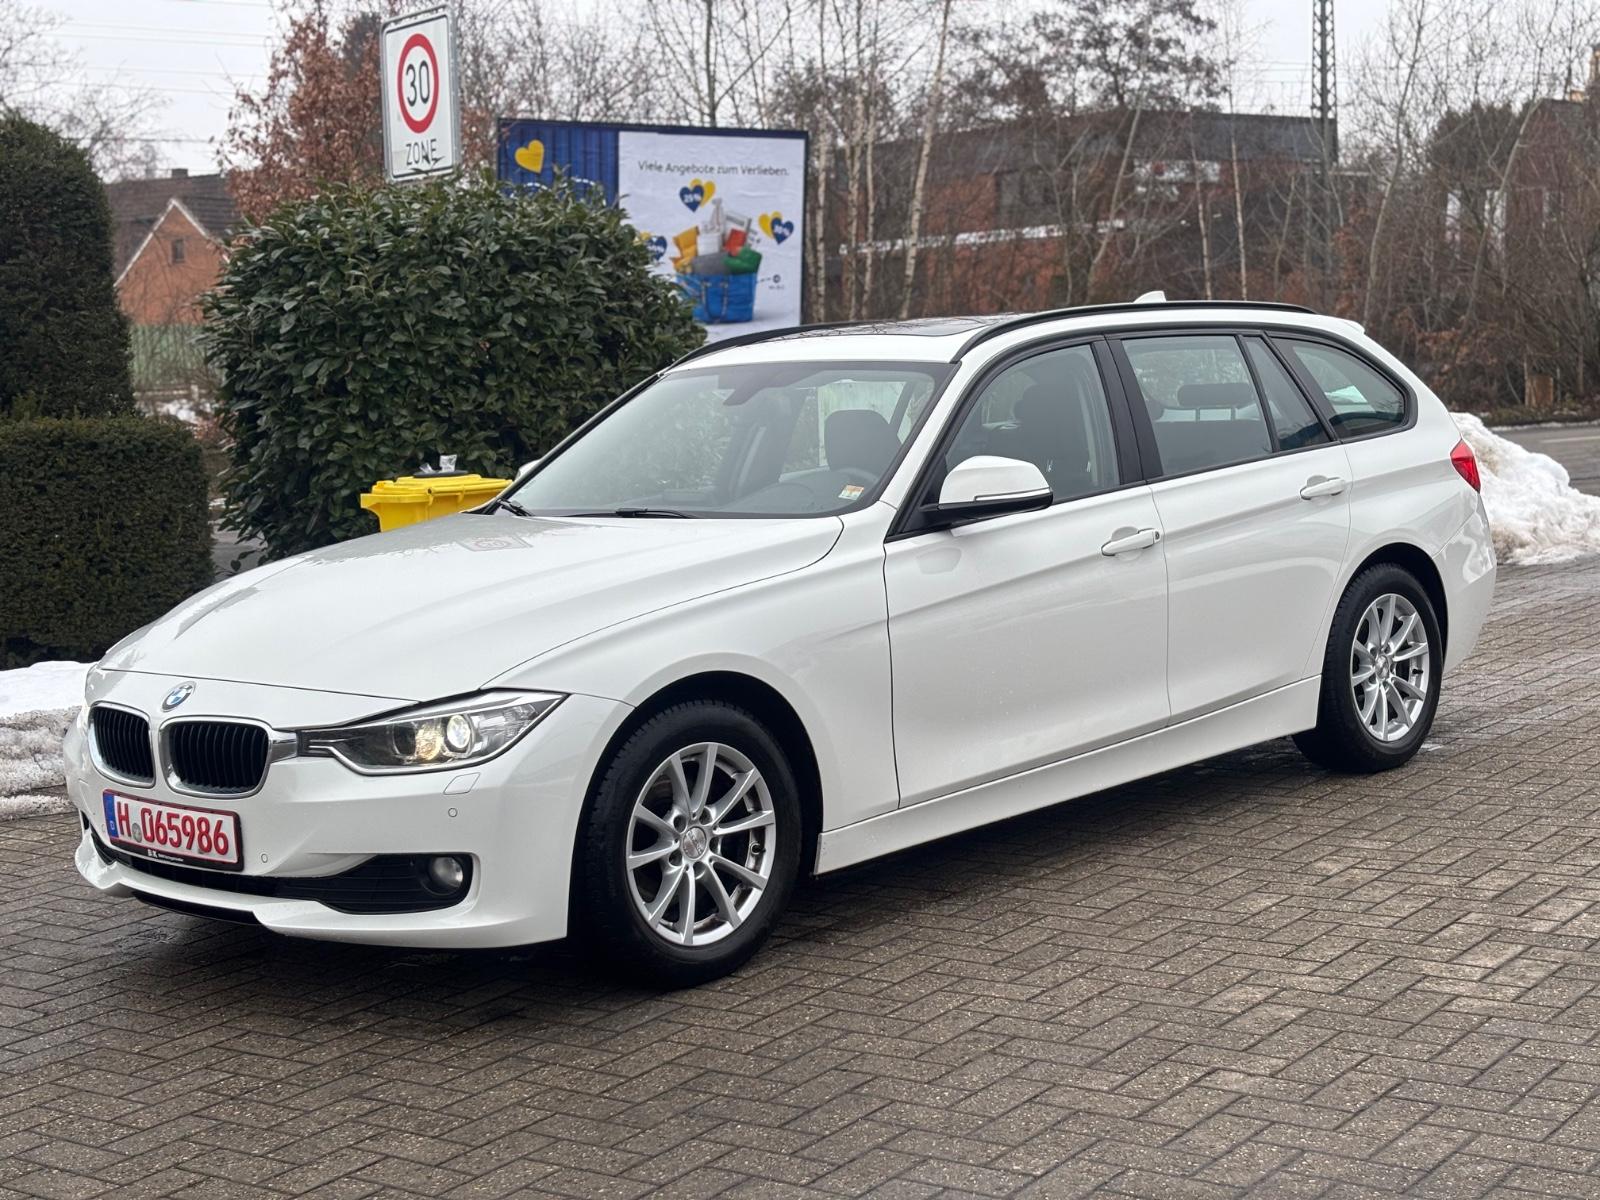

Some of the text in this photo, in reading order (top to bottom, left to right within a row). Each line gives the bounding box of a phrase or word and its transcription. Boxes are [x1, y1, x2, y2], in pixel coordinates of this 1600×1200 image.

[406, 60, 430, 107] 30
[406, 138, 437, 166] ZONE
[638, 161, 663, 173] Viele
[665, 164, 714, 176] Angebote
[717, 167, 739, 175] zum
[117, 801, 229, 855] H 065986
